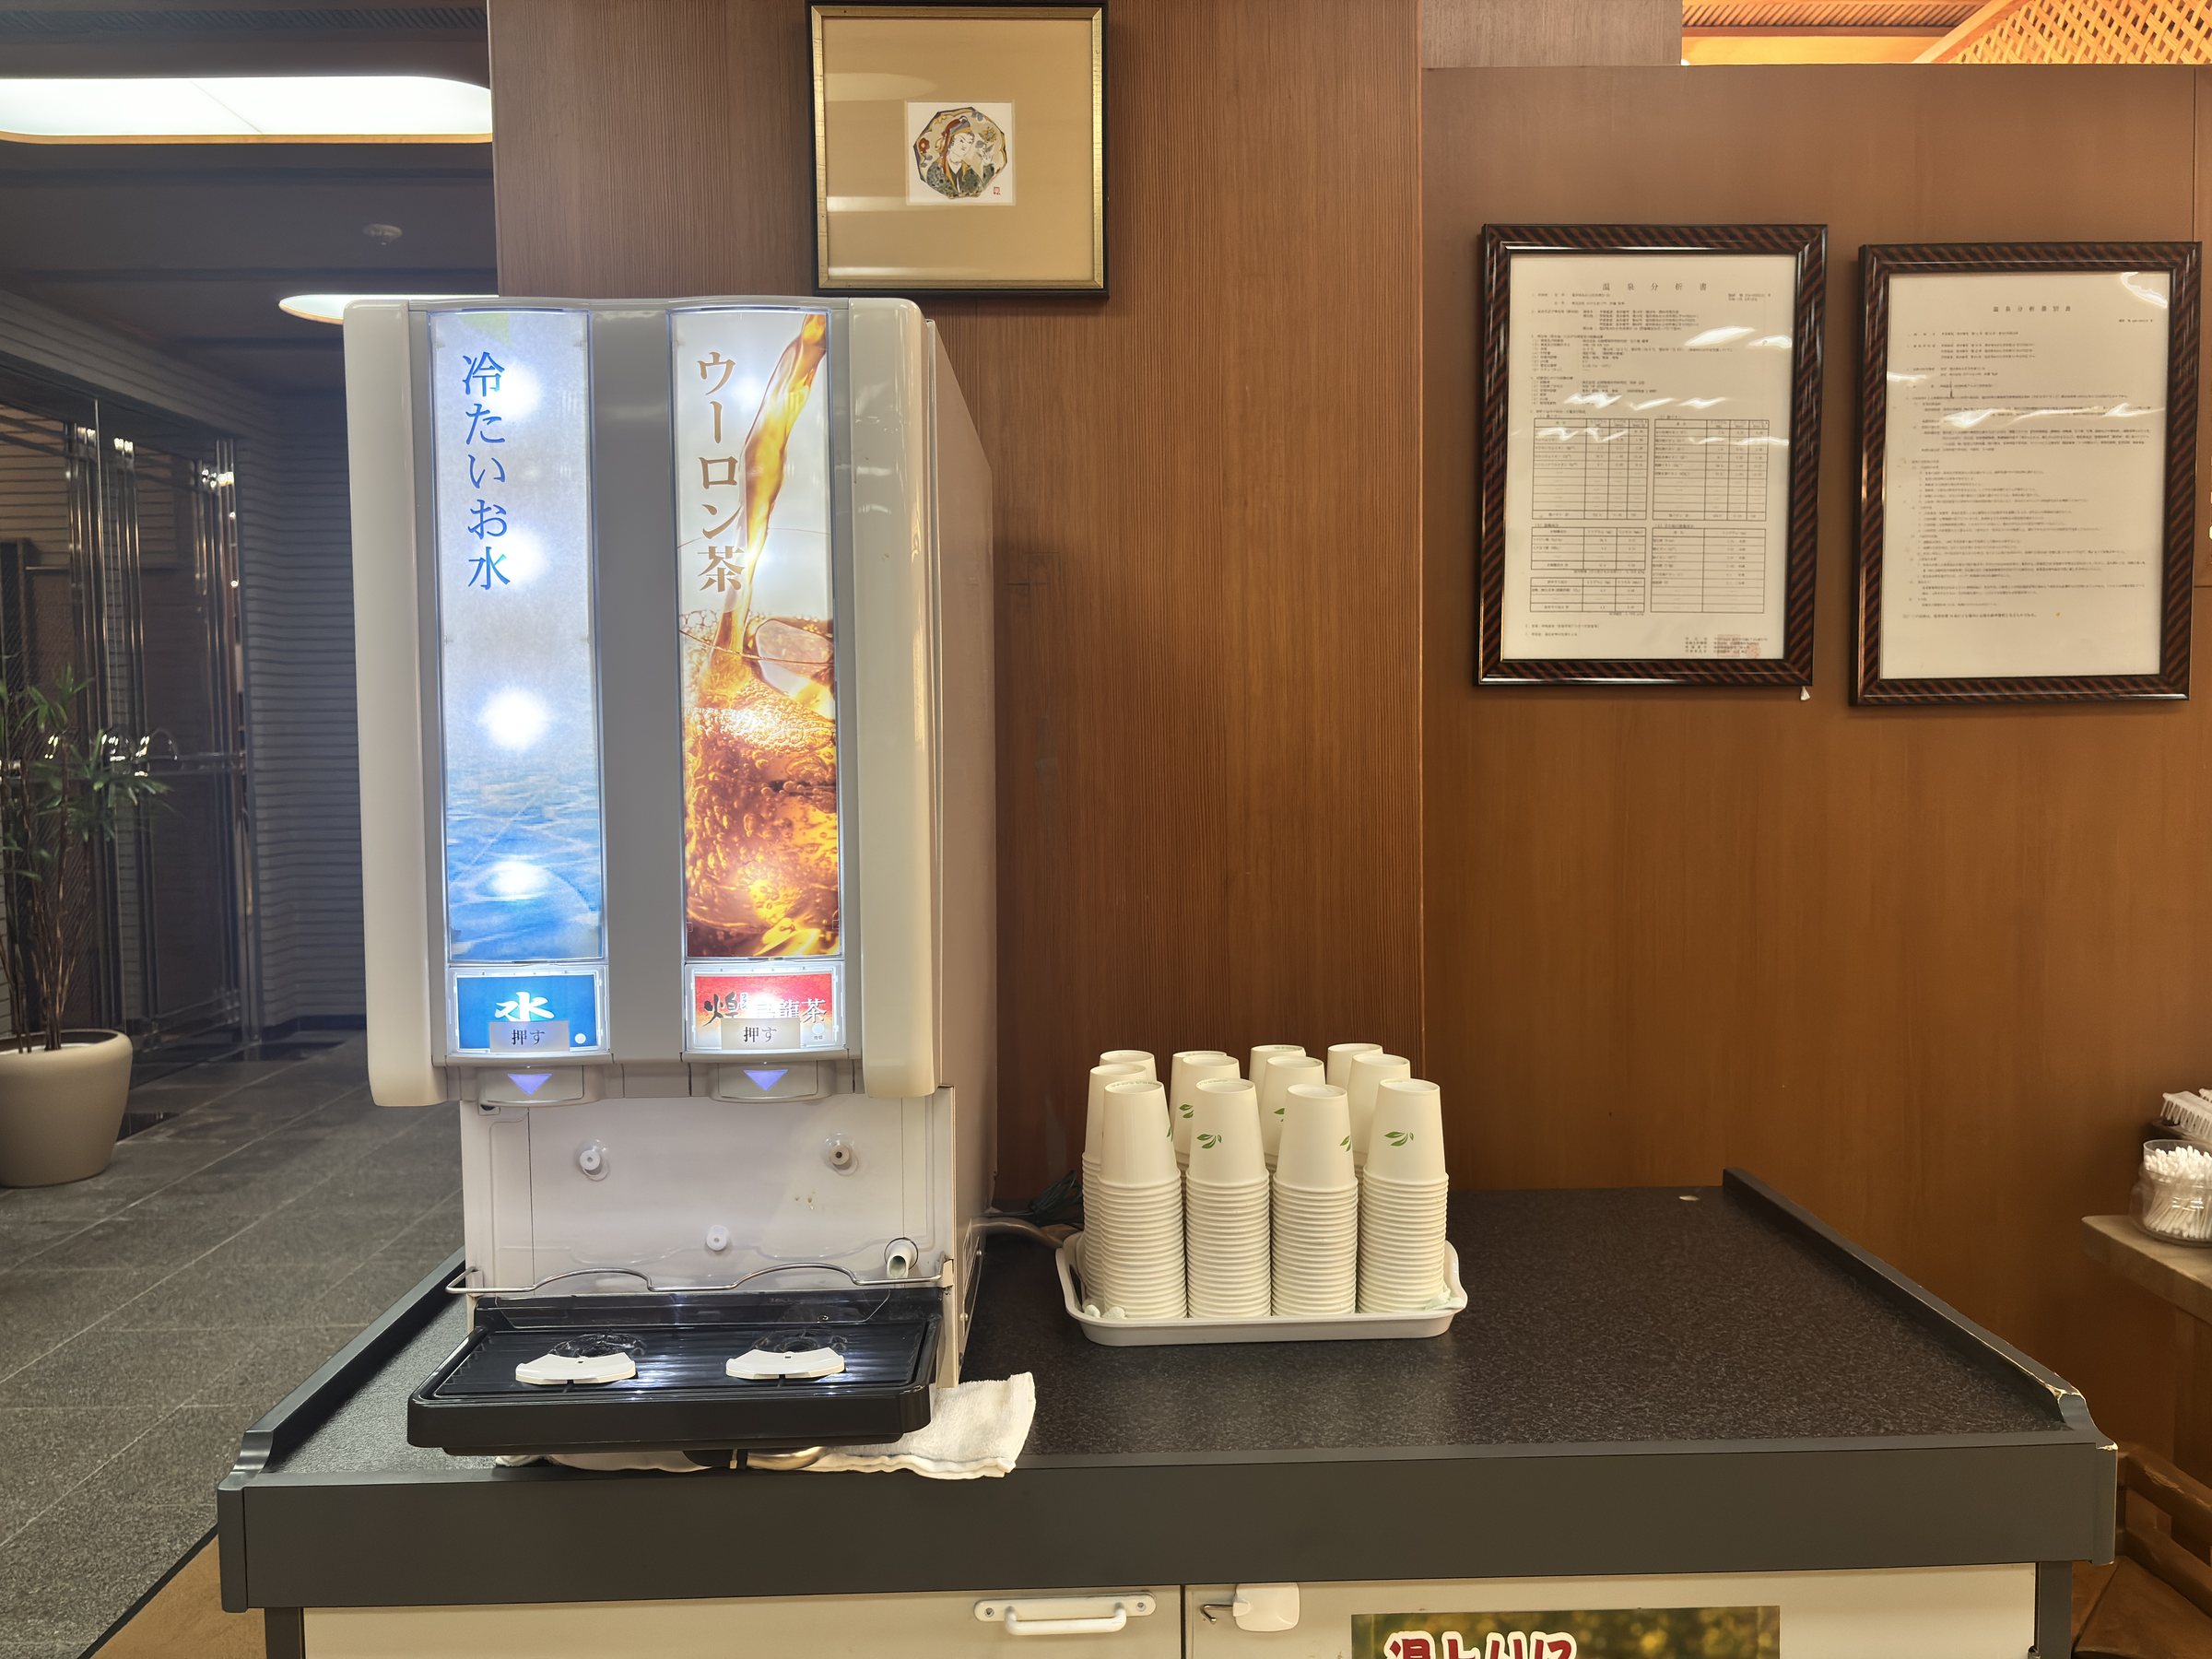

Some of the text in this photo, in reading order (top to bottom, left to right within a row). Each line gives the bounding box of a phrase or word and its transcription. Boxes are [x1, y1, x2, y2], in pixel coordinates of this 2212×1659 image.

[462, 351, 511, 591] 冷たいお水
[698, 351, 746, 593] ウーロン茶
[494, 991, 555, 1022] 水
[512, 1029, 546, 1045] 押す
[743, 1026, 777, 1043] 押す
